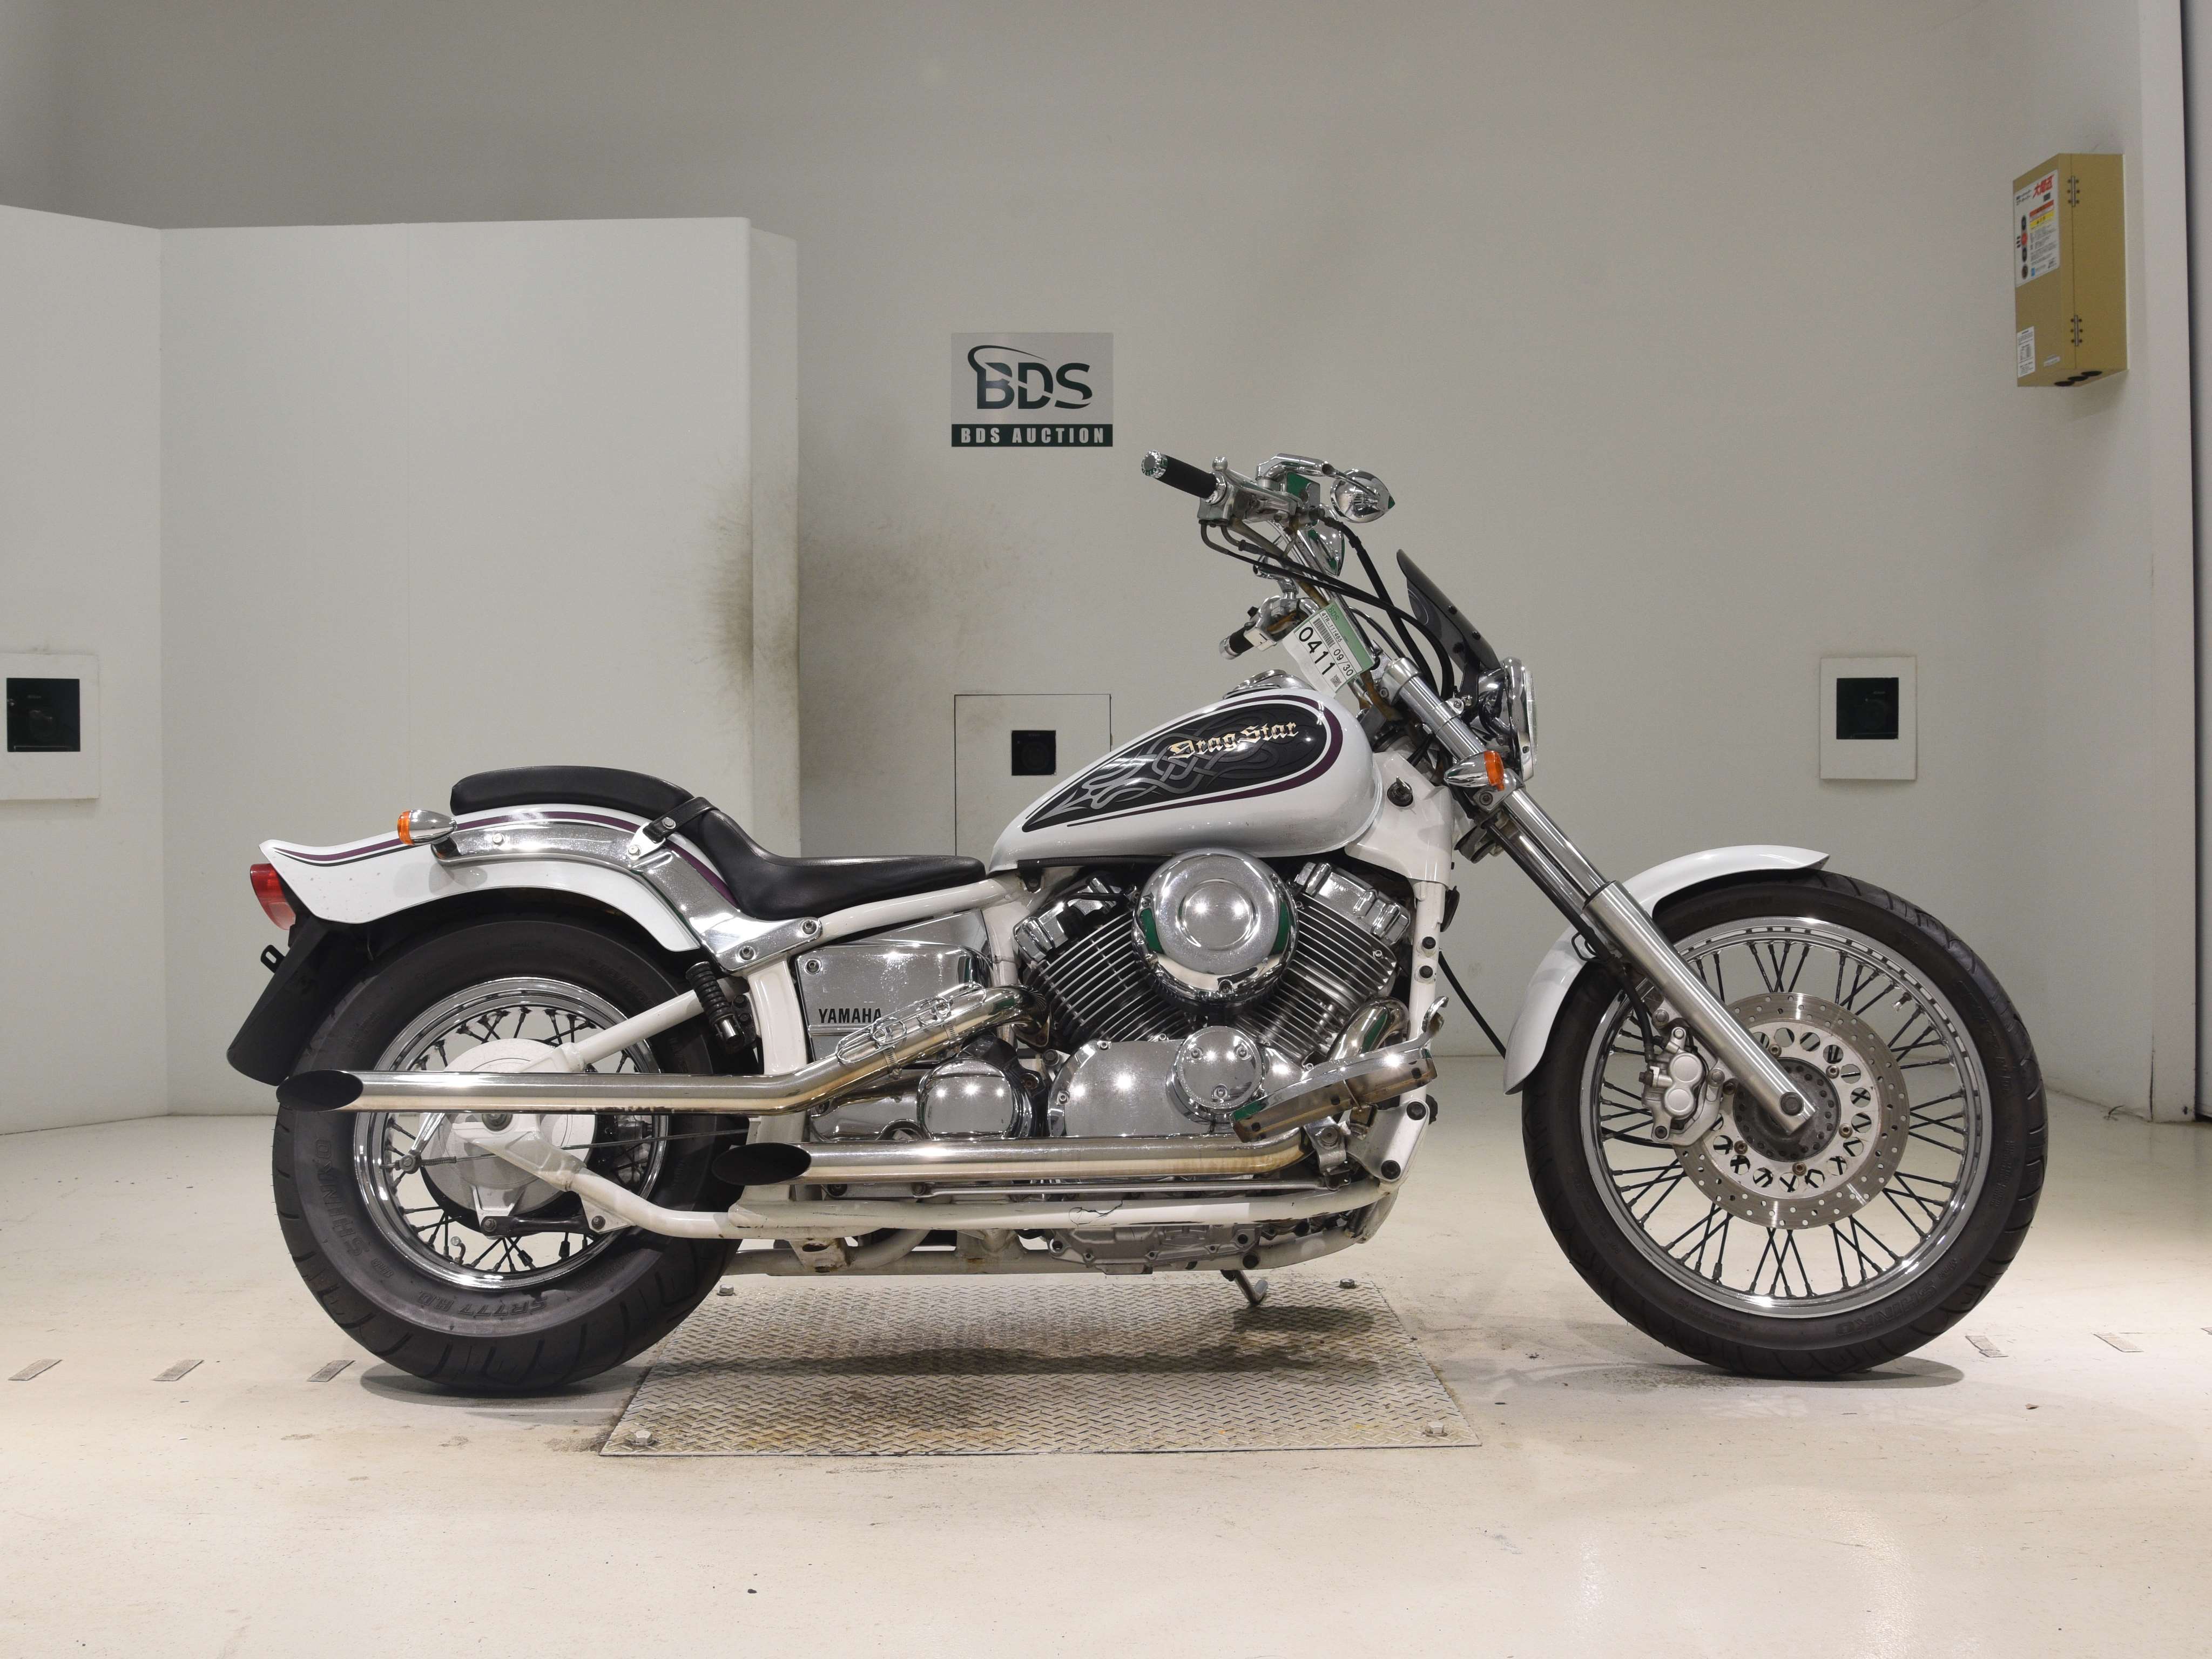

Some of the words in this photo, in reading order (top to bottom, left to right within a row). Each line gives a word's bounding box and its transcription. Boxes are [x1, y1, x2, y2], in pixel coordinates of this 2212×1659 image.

[968, 345, 1092, 409] BDS
[960, 427, 1000, 443] BDS
[1011, 427, 1104, 443] AUCTION
[1299, 626, 1335, 675] 0411
[1333, 649, 1354, 676] 09/30
[818, 1008, 882, 1023] YAMAHA
[315, 1138, 369, 1256] SHINKO
